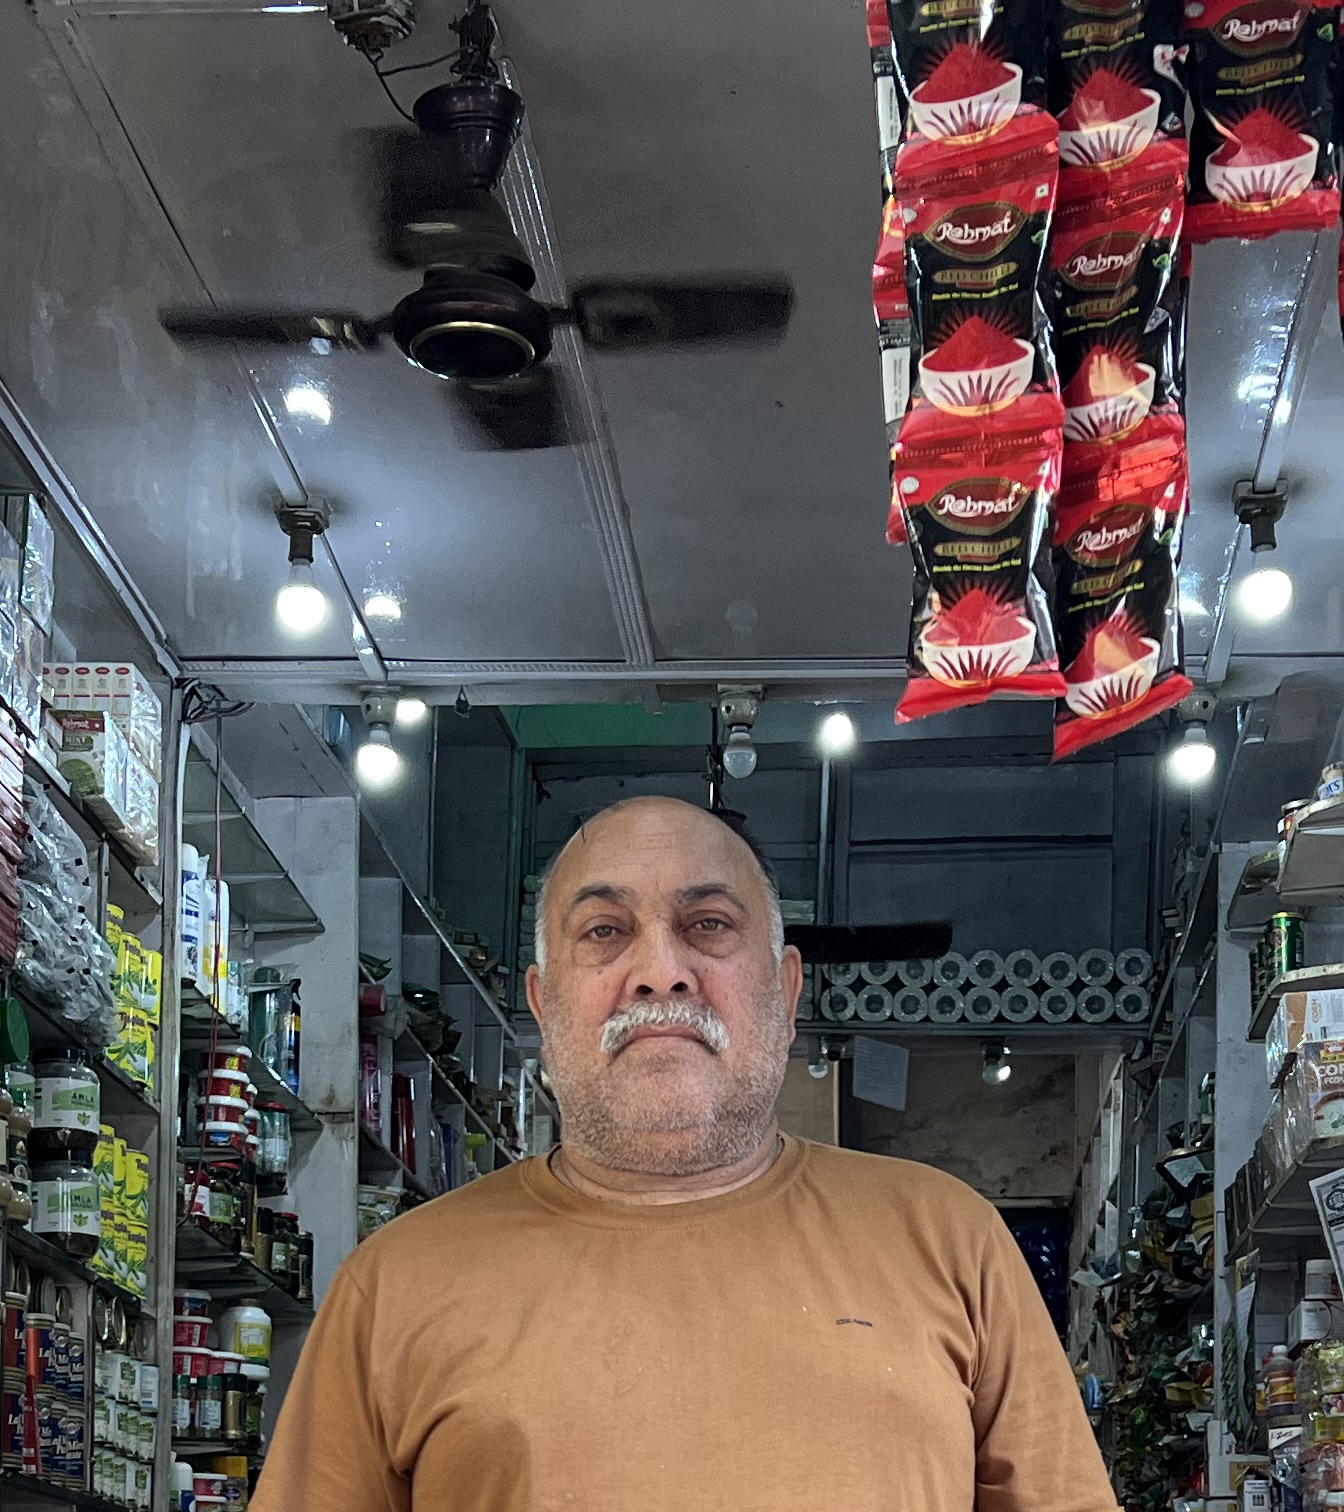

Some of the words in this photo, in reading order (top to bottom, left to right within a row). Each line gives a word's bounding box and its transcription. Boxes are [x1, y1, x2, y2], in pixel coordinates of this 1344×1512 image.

[1222, 14, 1301, 42] Rehmat
[936, 211, 1015, 244] Rehmat
[1071, 244, 1145, 276] Rehmat
[939, 492, 1018, 517] Rehmat
[1076, 516, 1145, 553] Rehmat
